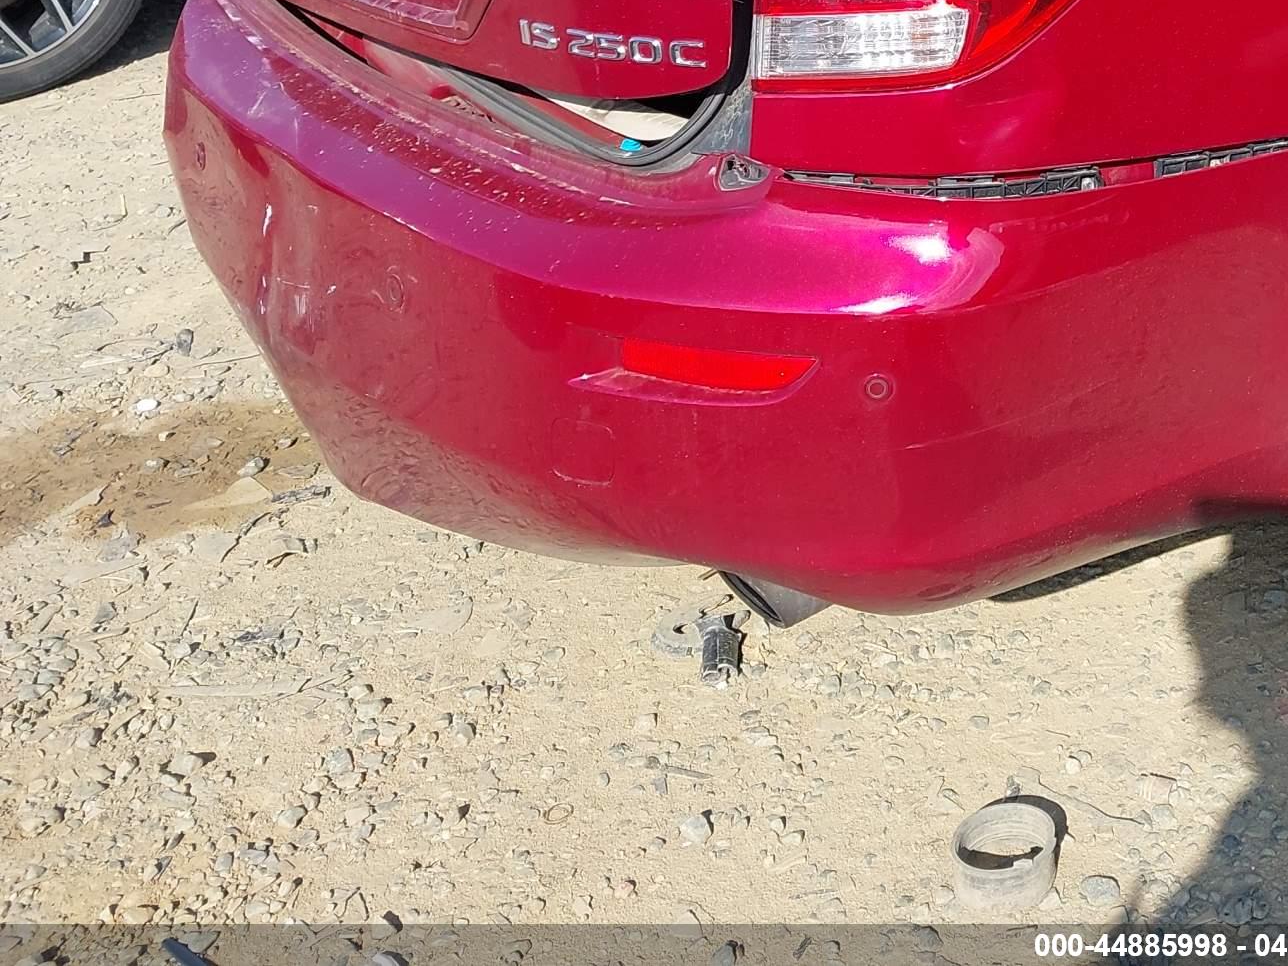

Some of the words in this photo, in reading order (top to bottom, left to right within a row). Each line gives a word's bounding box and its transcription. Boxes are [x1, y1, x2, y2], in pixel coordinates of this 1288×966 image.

[519, 18, 560, 50] IS
[566, 28, 663, 64] 250
[669, 38, 707, 68] C
